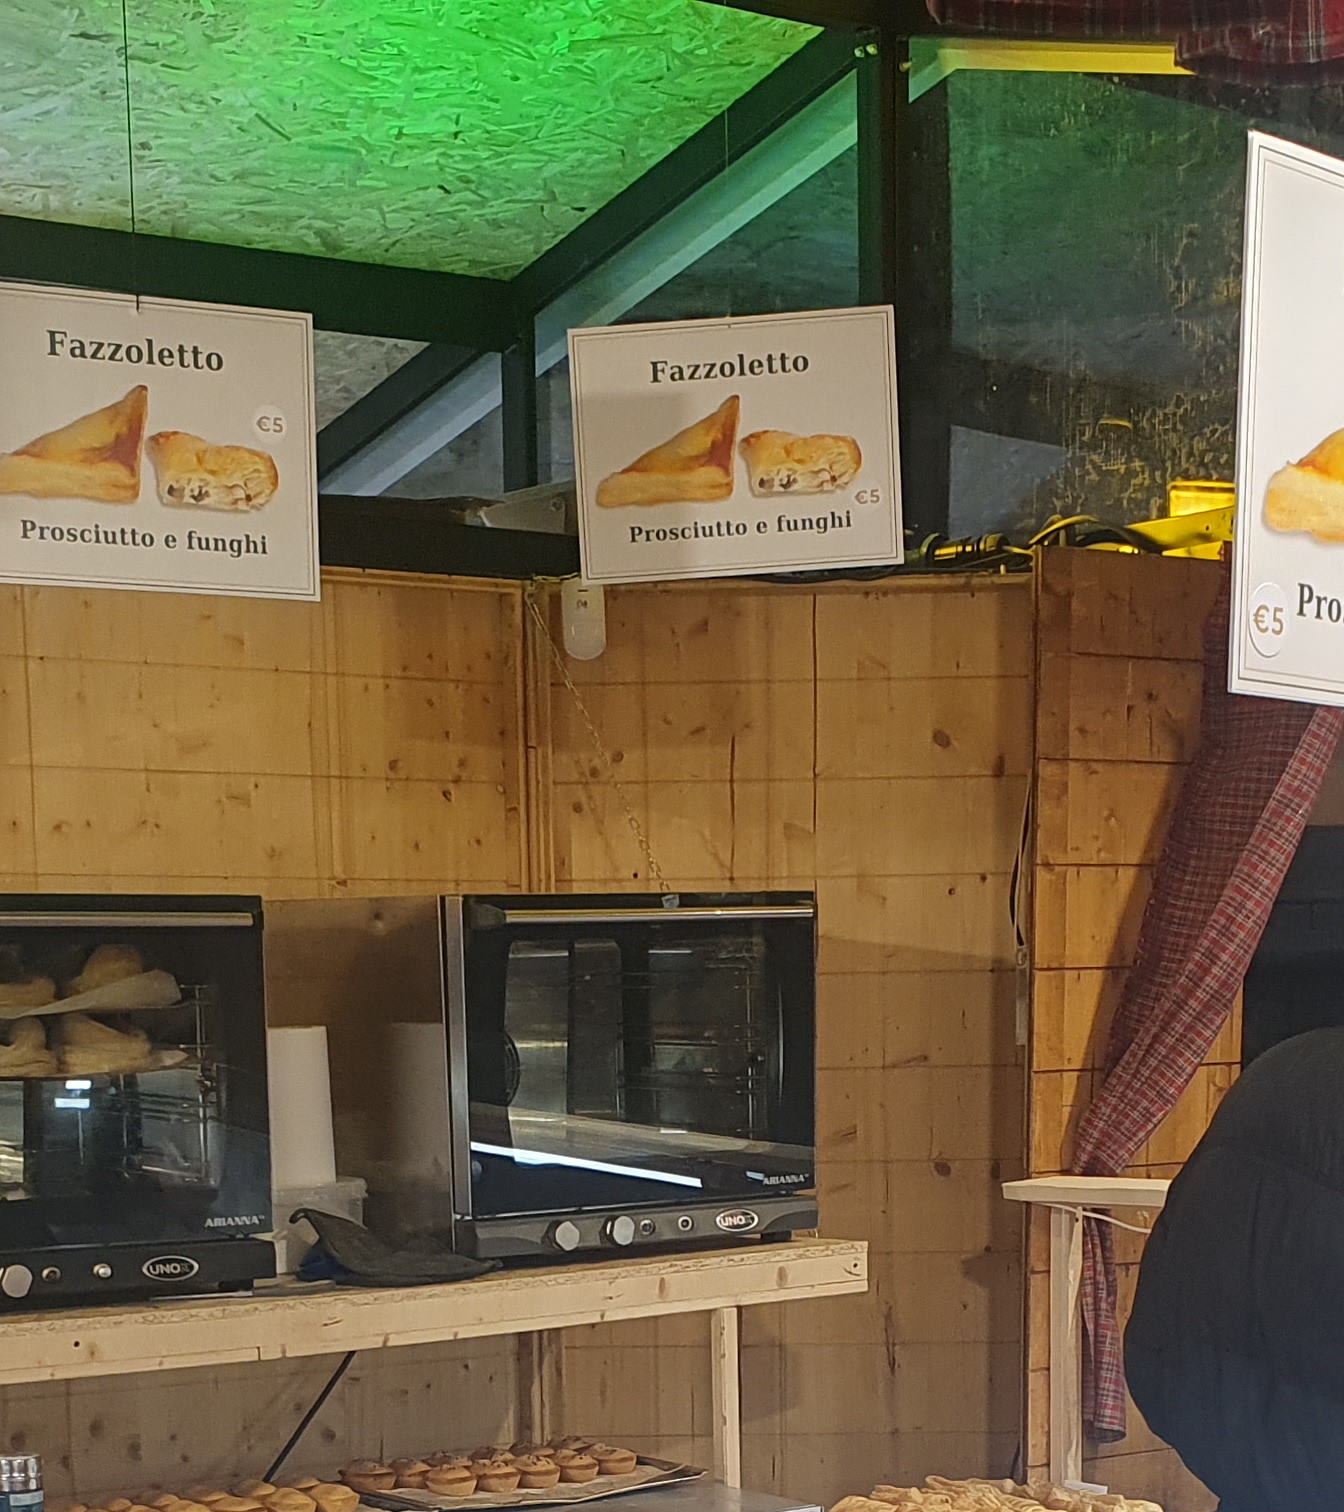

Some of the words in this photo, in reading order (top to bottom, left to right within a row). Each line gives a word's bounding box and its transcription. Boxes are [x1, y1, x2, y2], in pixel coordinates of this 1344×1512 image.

[46, 329, 224, 371] Fazzoletto
[649, 352, 809, 383] Fazzoletto
[256, 416, 283, 433] €5
[855, 490, 880, 504] €5
[20, 519, 155, 548] Prosciutto
[164, 532, 177, 549] e
[186, 530, 268, 558] funghi
[629, 520, 748, 543] Prosciutto
[756, 520, 768, 534] e
[777, 510, 852, 534] funghi
[1253, 605, 1284, 636] €5
